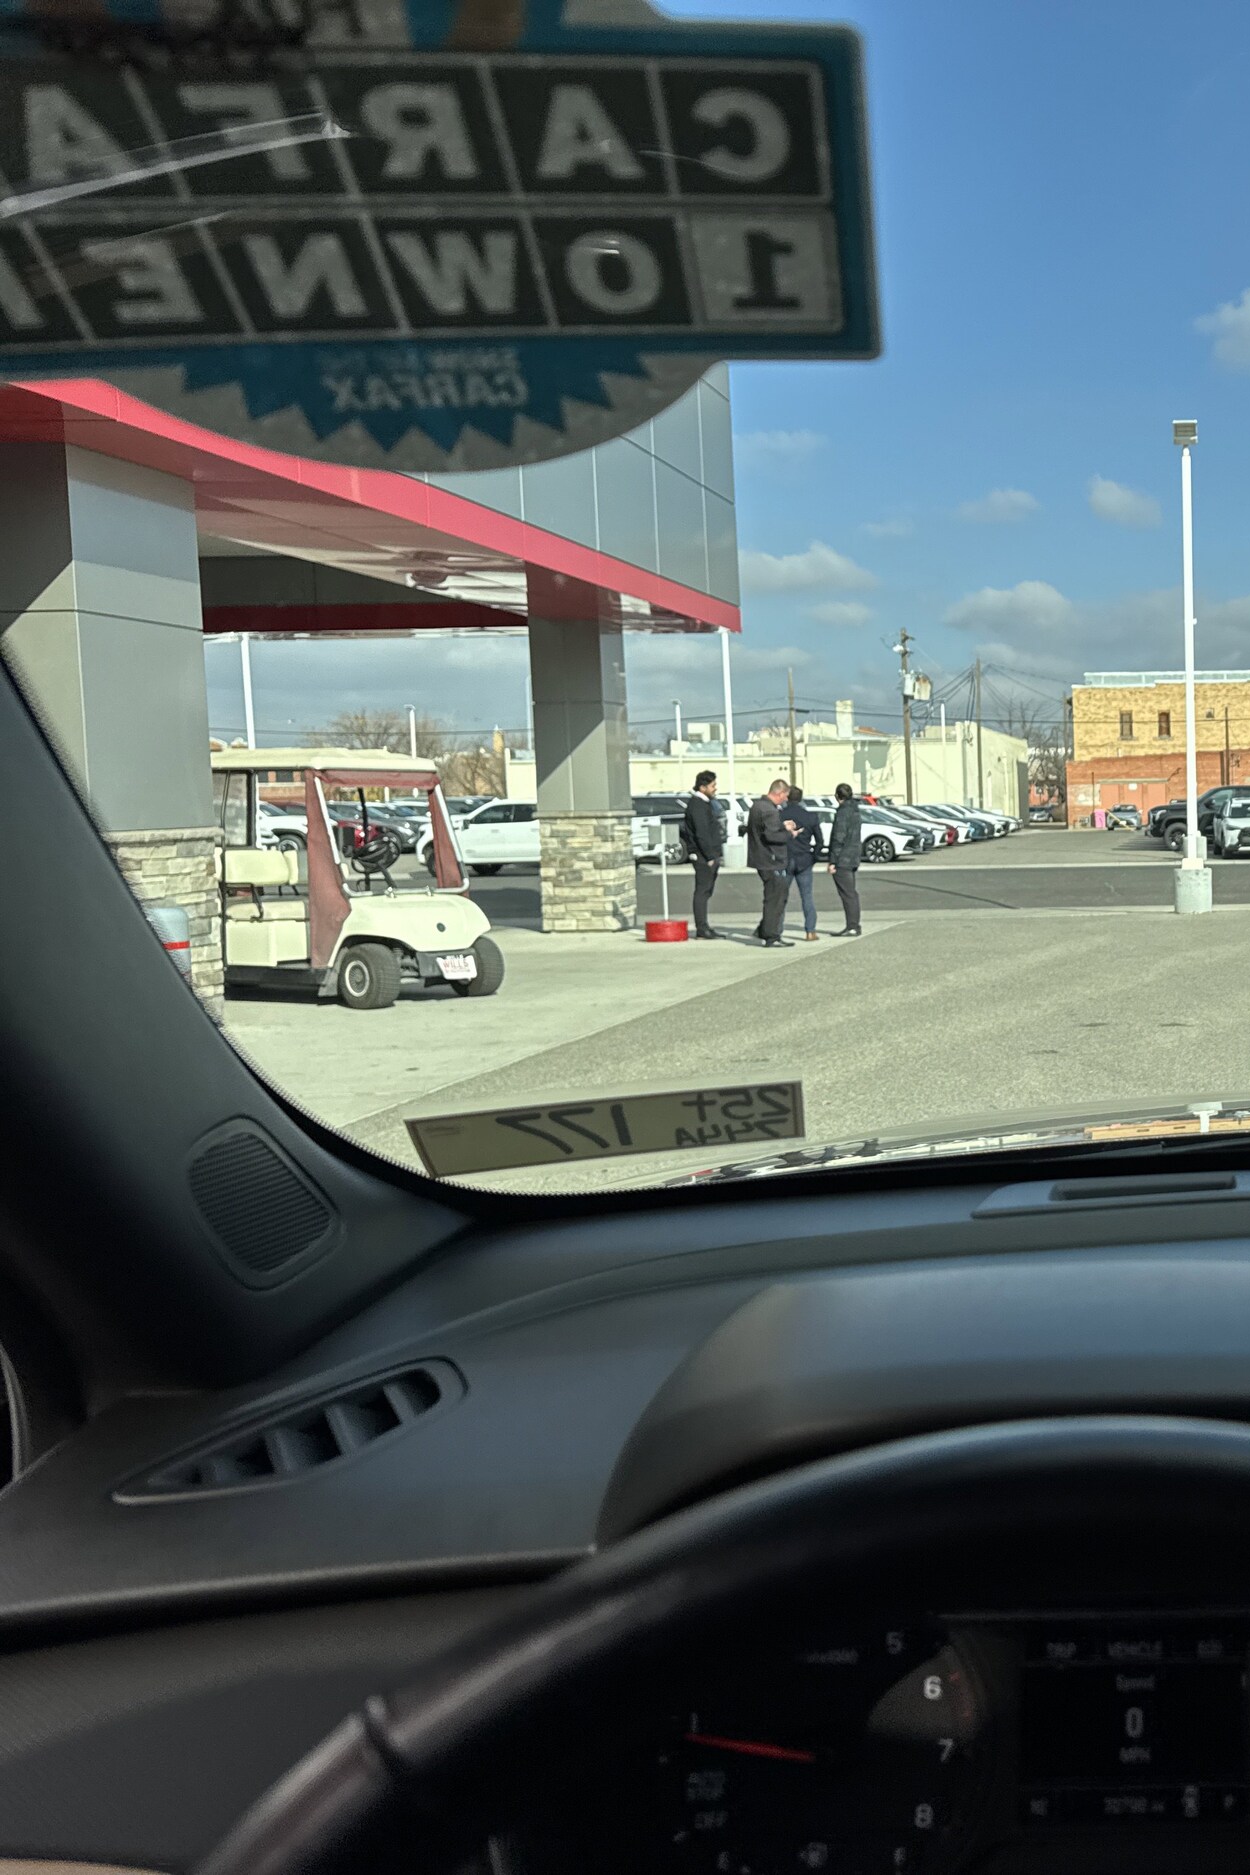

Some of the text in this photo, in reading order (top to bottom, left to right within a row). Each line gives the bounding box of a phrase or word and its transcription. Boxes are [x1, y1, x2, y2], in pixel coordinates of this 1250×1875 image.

[885, 1631, 905, 1655] 5
[922, 1674, 944, 1701] 6
[1124, 1706, 1145, 1739] 0
[938, 1737, 955, 1764] 7
[914, 1803, 935, 1829] 8
